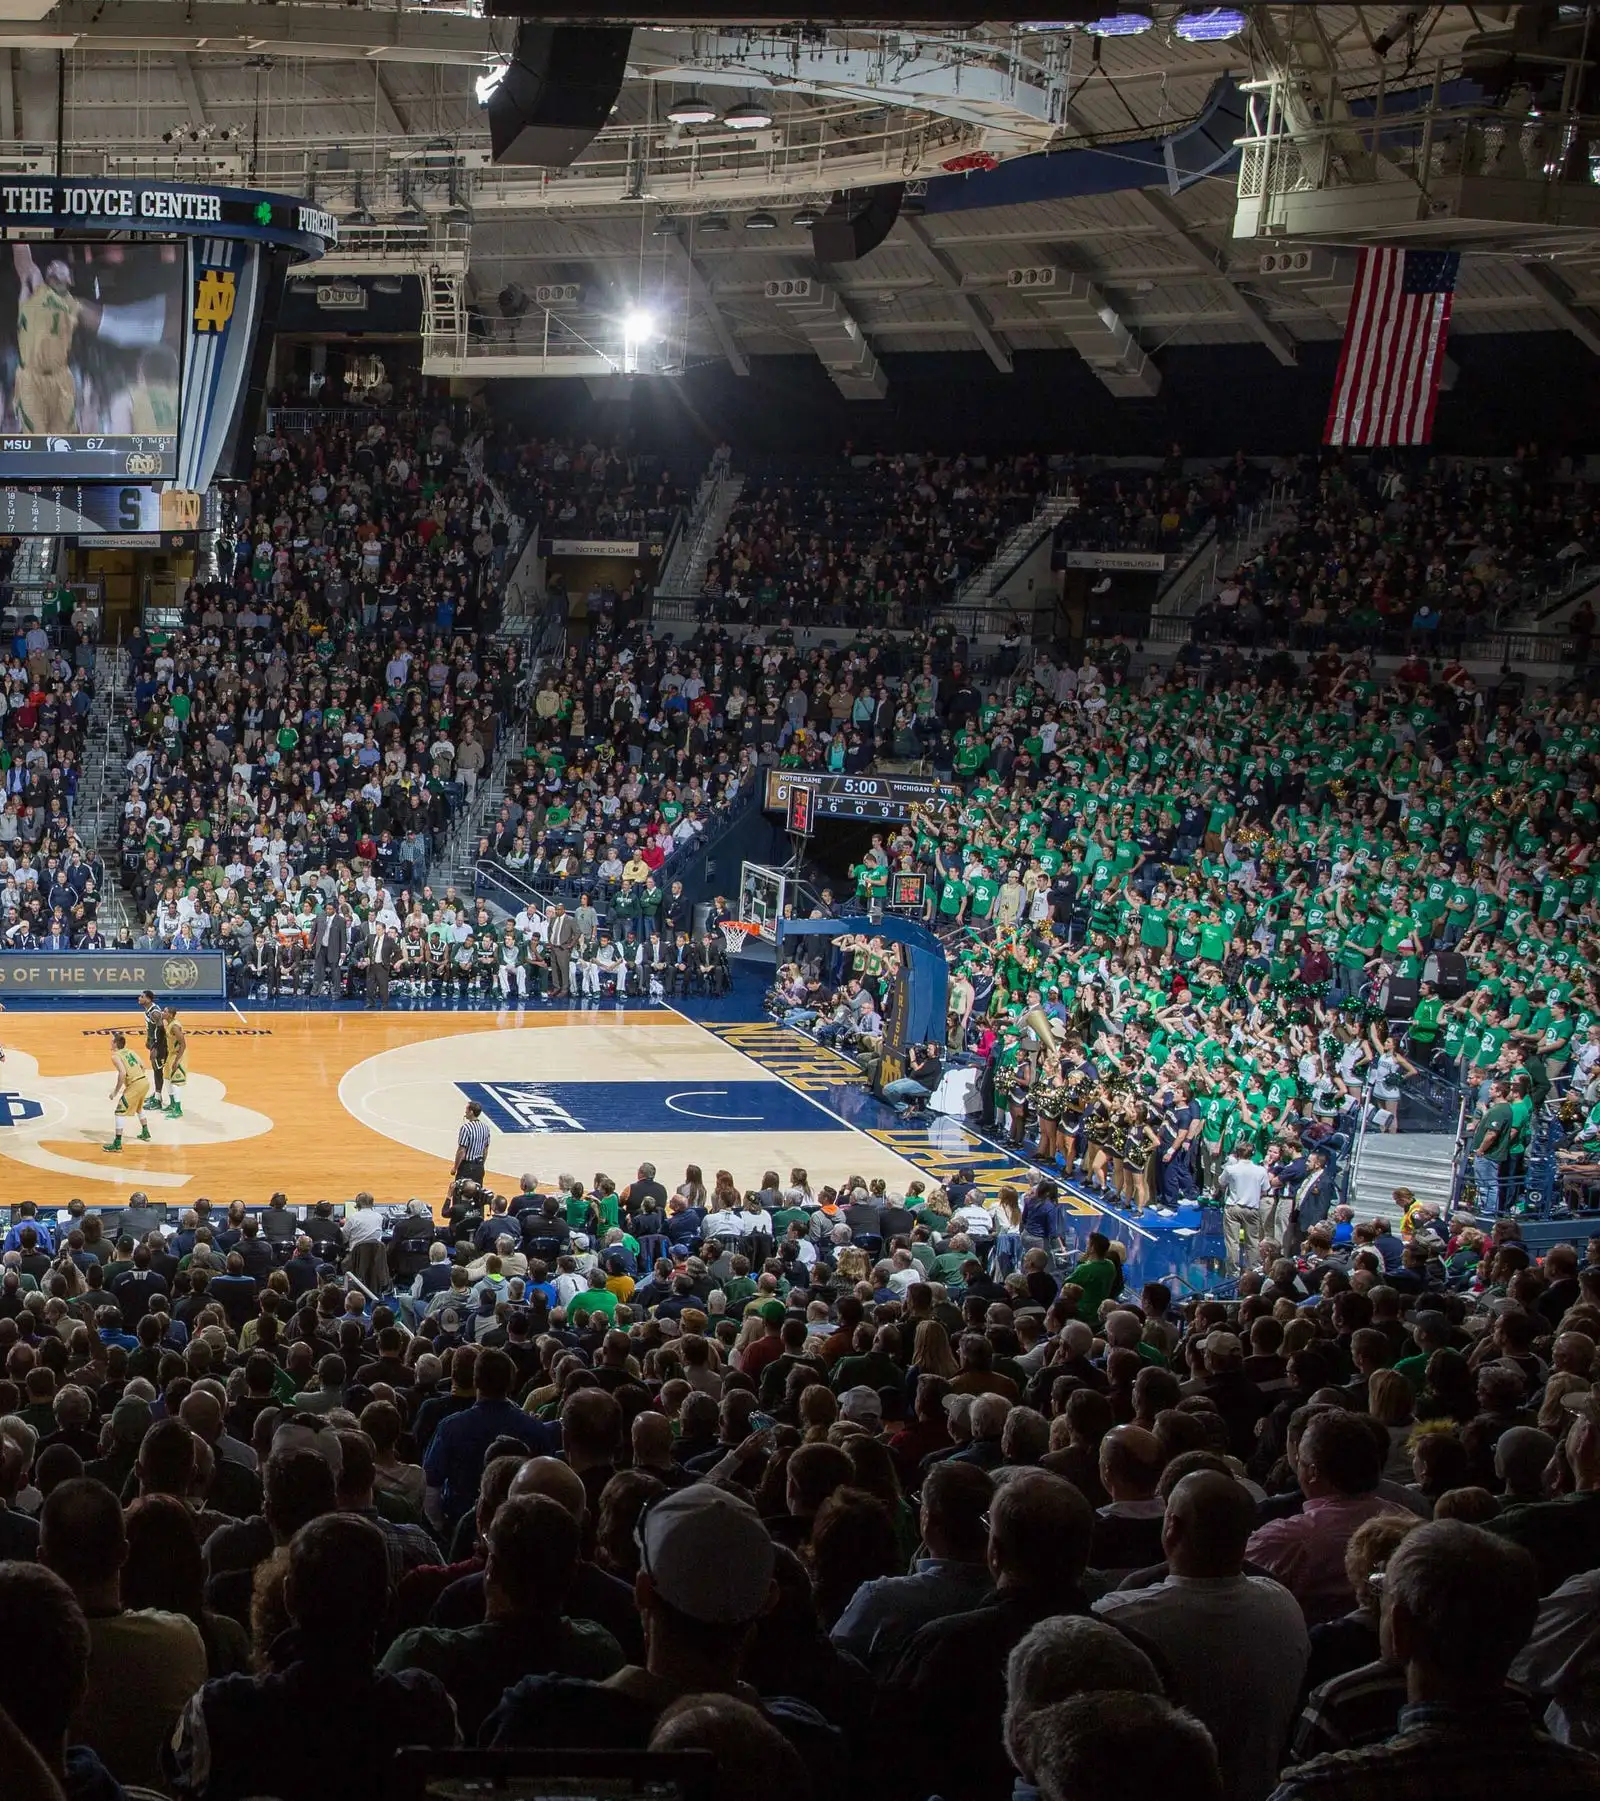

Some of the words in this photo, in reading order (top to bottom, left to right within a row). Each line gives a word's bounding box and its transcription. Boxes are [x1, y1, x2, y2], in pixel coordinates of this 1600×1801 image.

[3, 187, 53, 214] THE
[61, 188, 133, 215] JOYCE
[140, 190, 221, 221] CENTER
[3, 440, 32, 450] MSU
[86, 438, 105, 450] 67
[7, 508, 16, 516] 14
[32, 508, 39, 516] 18
[7, 524, 15, 532] 17
[92, 536, 119, 545] NORTH
[120, 536, 157, 546] CAROLINA
[575, 546, 606, 554] NOTRE
[608, 546, 635, 555] DAME
[779, 775, 801, 783] NOTRE
[802, 776, 822, 784] DAME
[844, 779, 877, 794] 5:00
[893, 784, 929, 793] MICHIGAN
[930, 787, 953, 795] STE
[830, 802, 837, 812] 6
[881, 807, 889, 817] 9
[13, 968, 40, 983] OF
[48, 968, 85, 982] THE
[92, 968, 145, 982] YEAR
